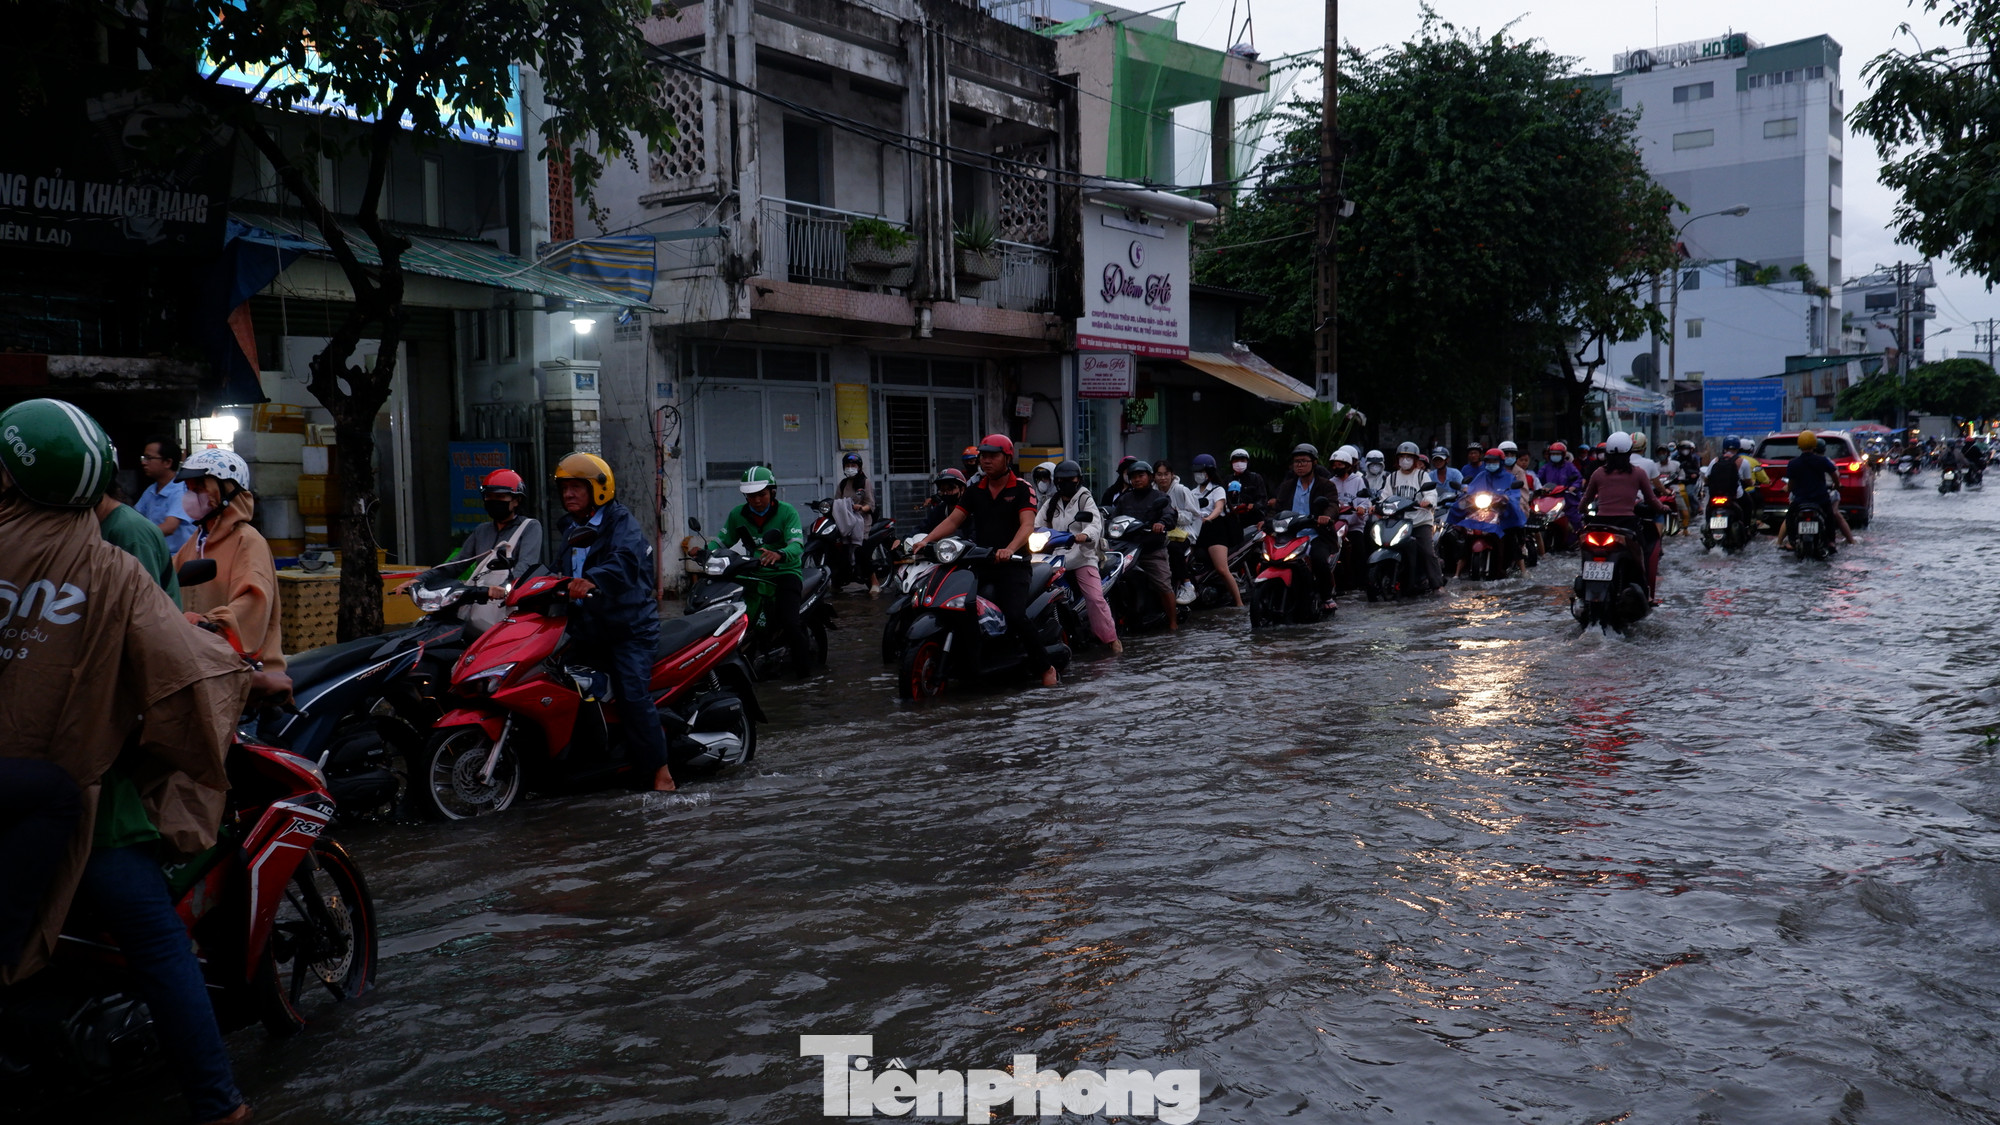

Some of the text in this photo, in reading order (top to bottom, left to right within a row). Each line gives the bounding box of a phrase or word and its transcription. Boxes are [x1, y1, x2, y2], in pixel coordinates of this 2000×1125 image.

[1702, 35, 1744, 58] HOTEL
[33, 167, 76, 212] CỦA
[82, 178, 150, 219] KHÁCH
[155, 184, 209, 224] HÀNG
[4, 425, 37, 467] Grab
[17, 646, 29, 660] 3
[316, 803, 335, 816] 110
